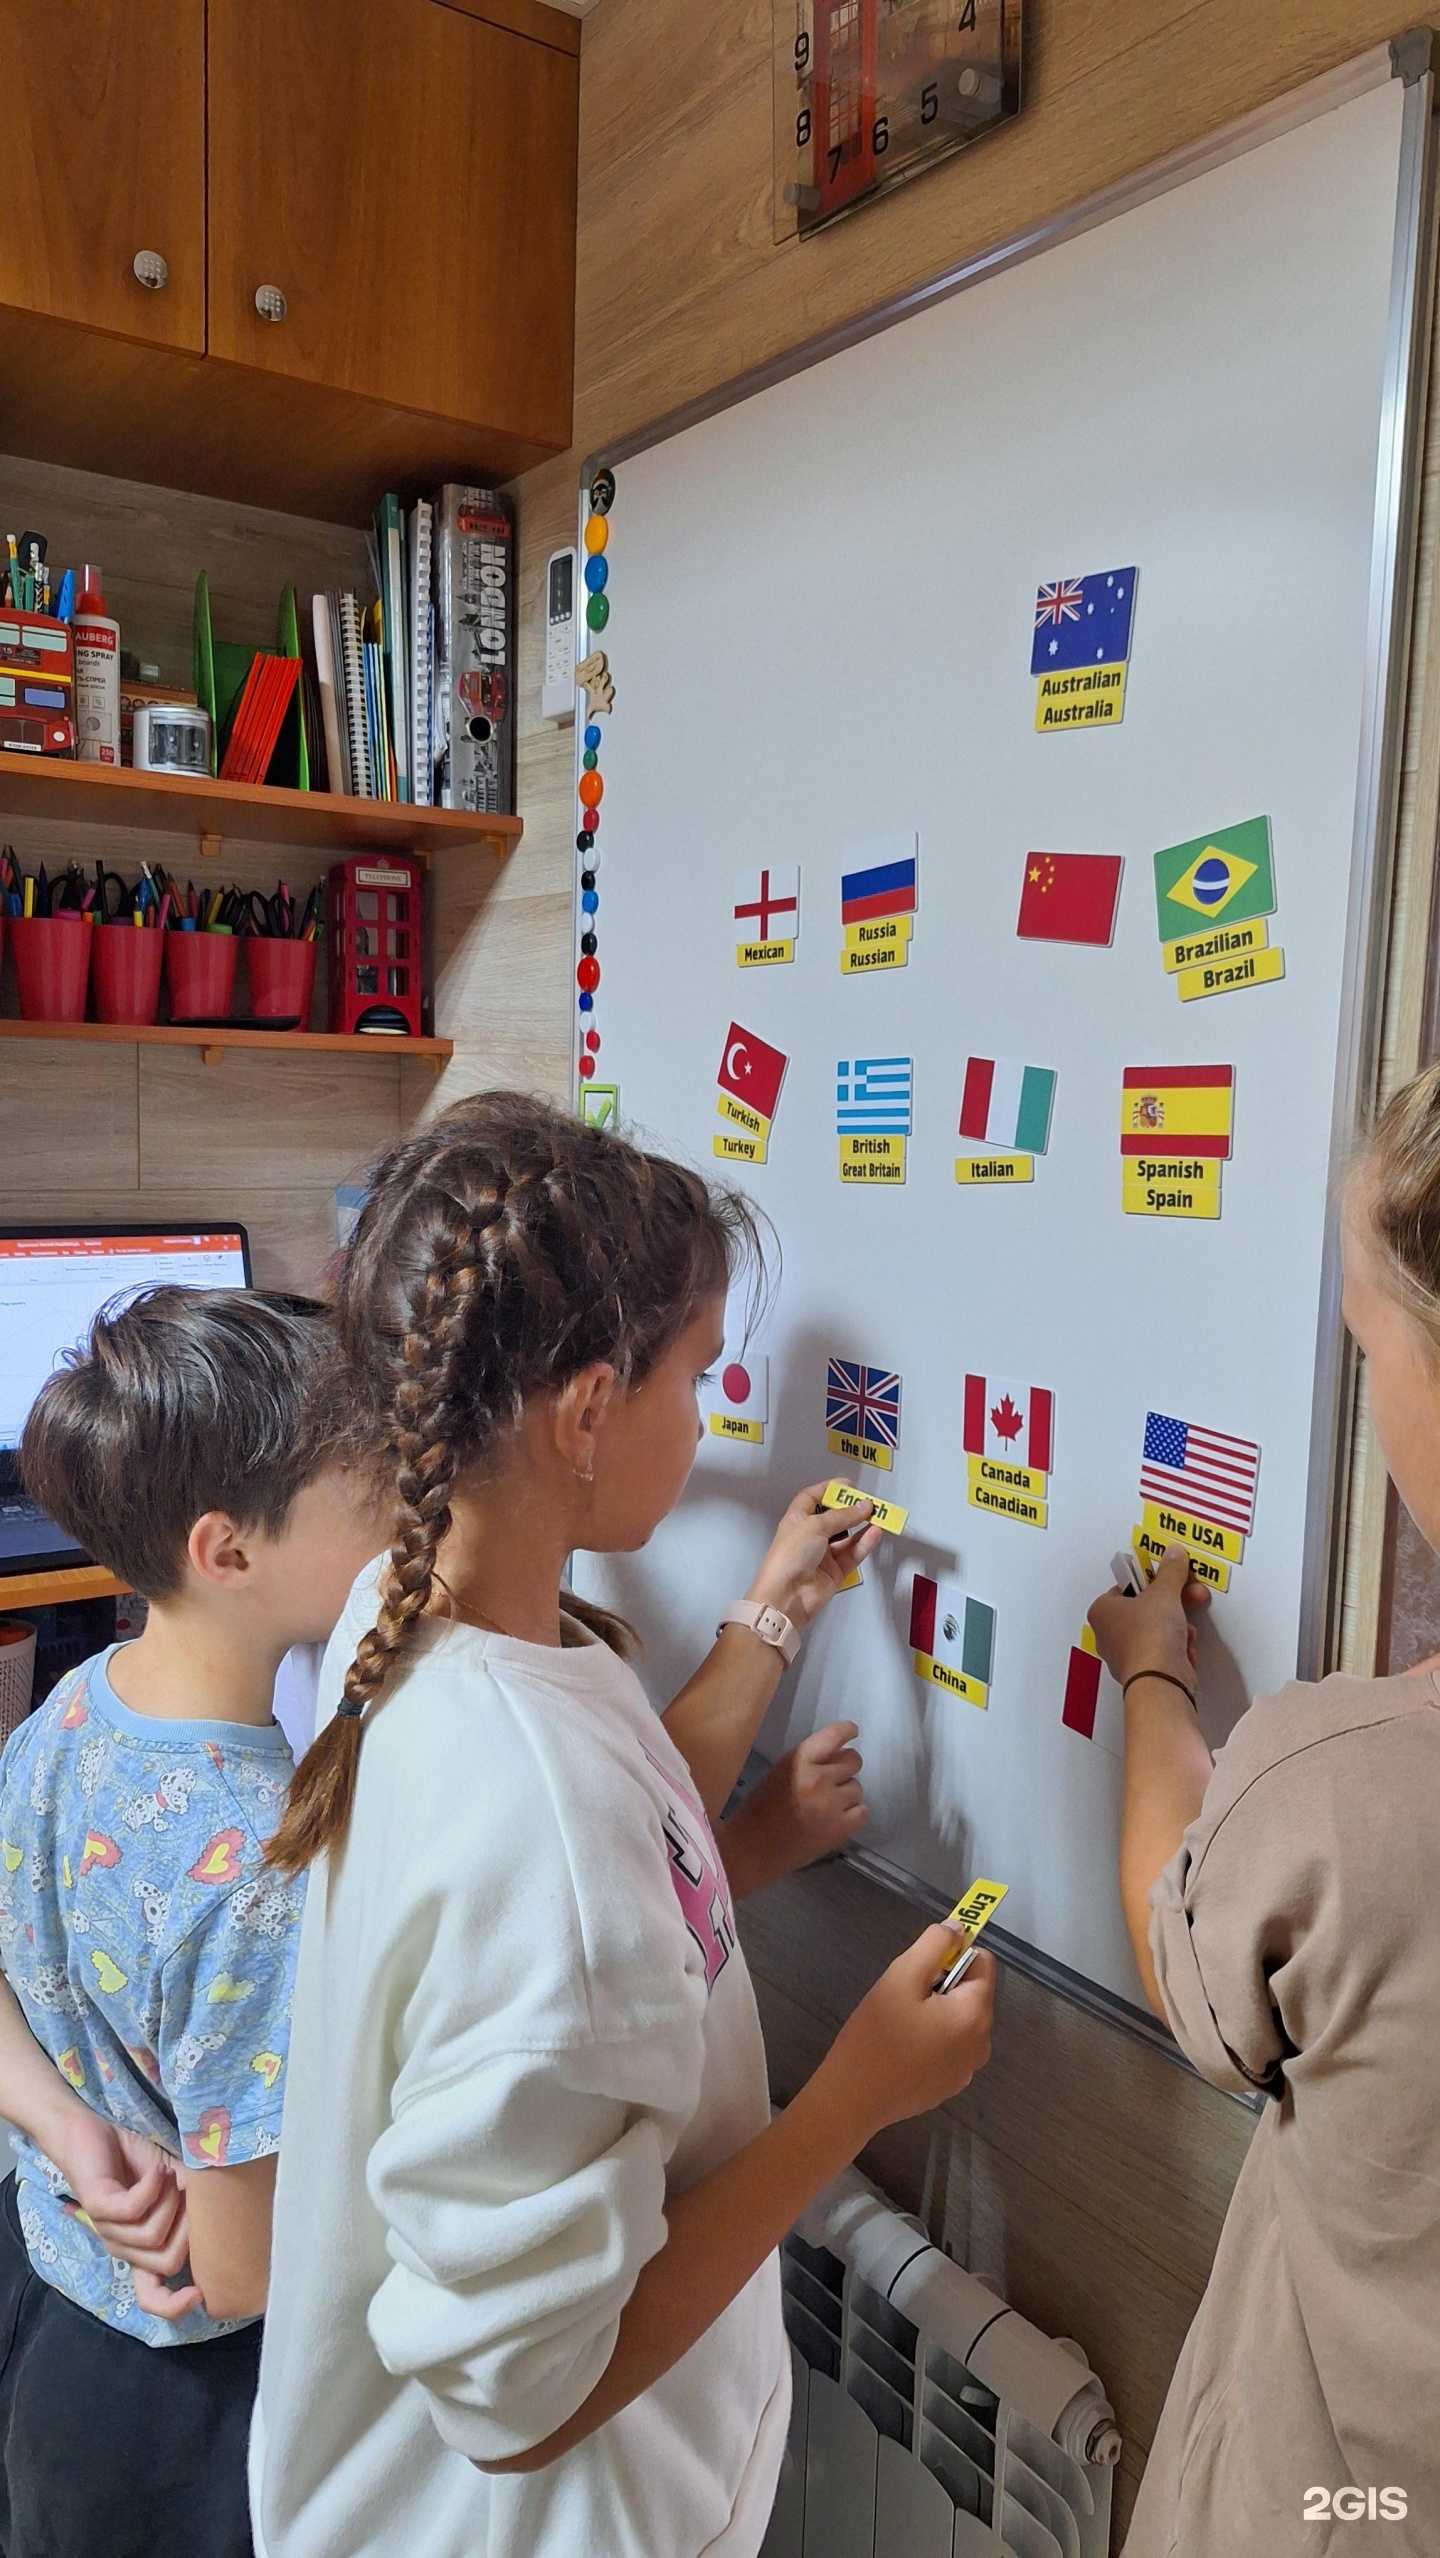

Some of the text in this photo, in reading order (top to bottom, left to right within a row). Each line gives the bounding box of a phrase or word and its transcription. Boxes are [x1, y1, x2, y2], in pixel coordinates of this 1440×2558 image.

[958, 0, 977, 32] 4
[794, 31, 810, 71] 9
[920, 82, 939, 125] 5
[796, 108, 812, 147] 8
[872, 116, 889, 155] 6
[827, 144, 844, 184] 7
[480, 543, 506, 666] LONDON
[91, 650, 113, 661] SPRAY
[1041, 668, 1121, 697] Australian
[1043, 698, 1114, 725] Australia
[858, 922, 897, 942] Russia
[1174, 929, 1253, 964] Brazilian
[744, 945, 785, 962] Mexican
[850, 947, 896, 968] Russian
[1202, 958, 1256, 989] Brazil
[726, 1101, 760, 1132] Turkish
[722, 1138, 756, 1159] Turkey
[852, 1139, 890, 1154] British
[842, 1161, 901, 1178] Great Britain
[971, 1161, 1014, 1178] Italian
[1137, 1160, 1203, 1182] Spanish
[1146, 1188, 1193, 1211] Spain
[721, 1418, 749, 1435] Japan
[841, 1438, 877, 1463] the UK
[980, 1461, 1031, 1489] Canada
[836, 1488, 889, 1520] Ensh
[975, 1487, 1038, 1521] Canadian
[1159, 1511, 1225, 1551] the USA
[1139, 1533, 1219, 1582] Amcan
[931, 1664, 967, 1694] China
